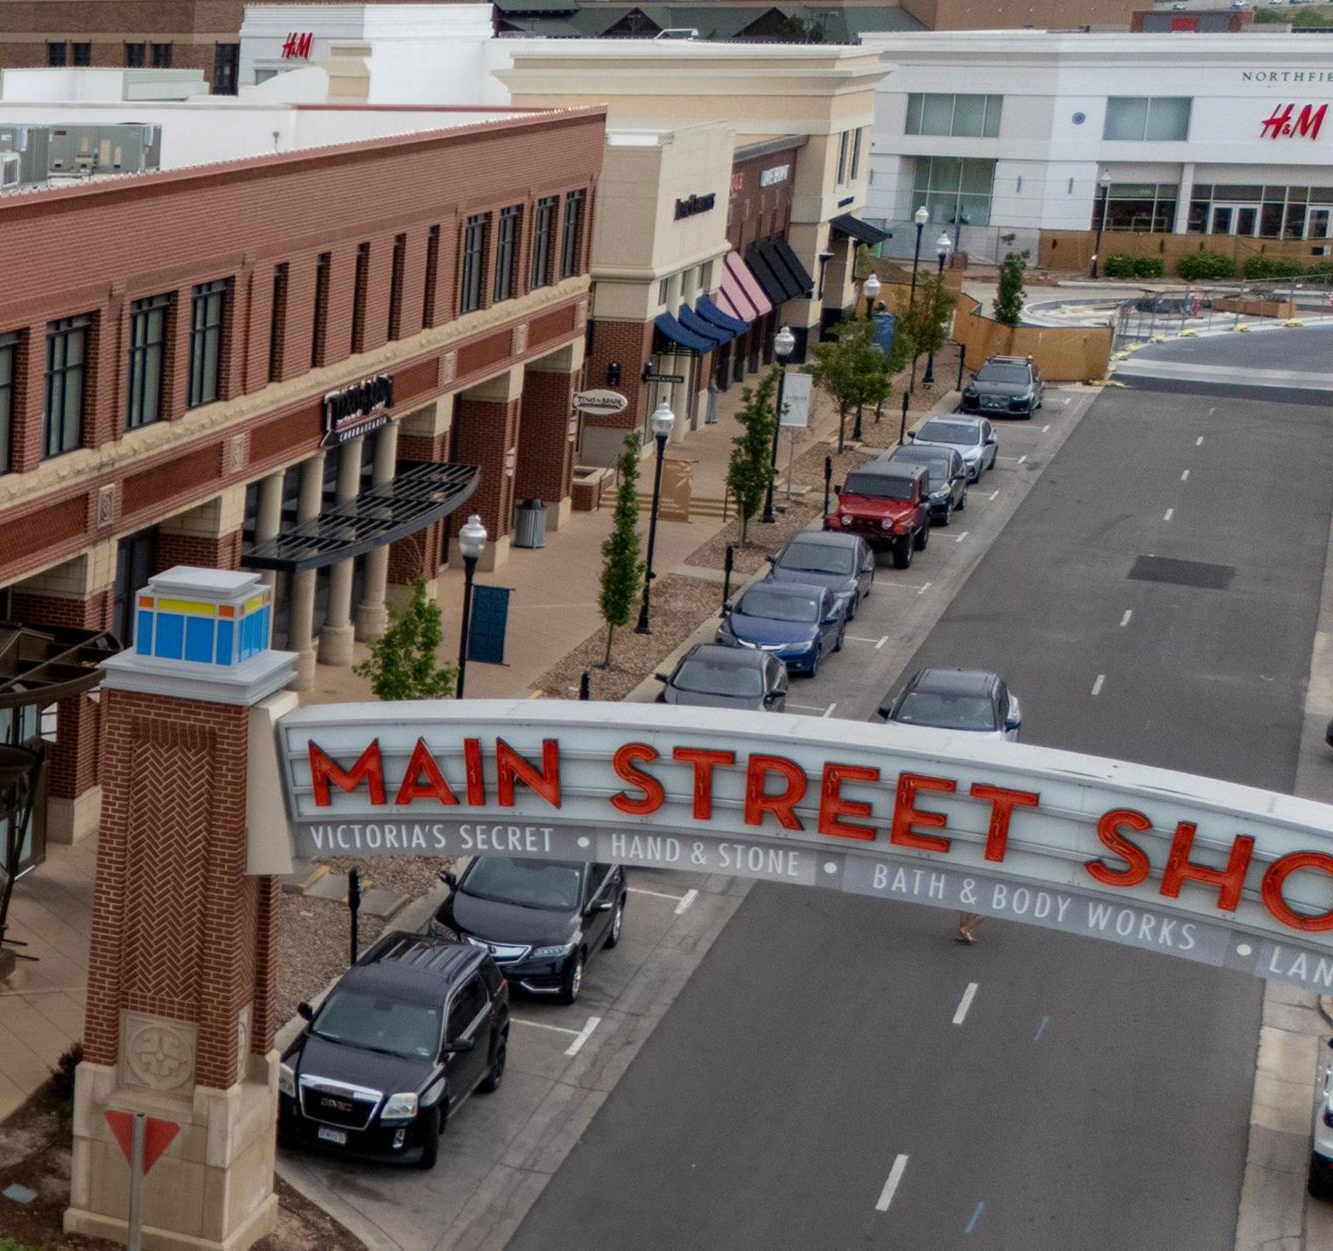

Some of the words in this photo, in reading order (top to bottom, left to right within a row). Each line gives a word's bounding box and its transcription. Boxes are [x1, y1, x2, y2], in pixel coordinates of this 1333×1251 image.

[281, 32, 313, 60] H&M
[1259, 103, 1329, 141] H&M
[308, 736, 562, 809] MAIN
[609, 742, 1041, 863] STREET
[1084, 806, 1333, 933] SHO
[310, 824, 447, 849] VICTORIA'S
[460, 828, 554, 852] SECRET
[611, 833, 681, 867] HAND
[691, 842, 708, 866] &
[718, 843, 800, 877] STONE
[872, 863, 946, 899] BATH
[959, 878, 978, 906] &
[991, 884, 1071, 923] BODY
[1088, 902, 1197, 950] WORKS
